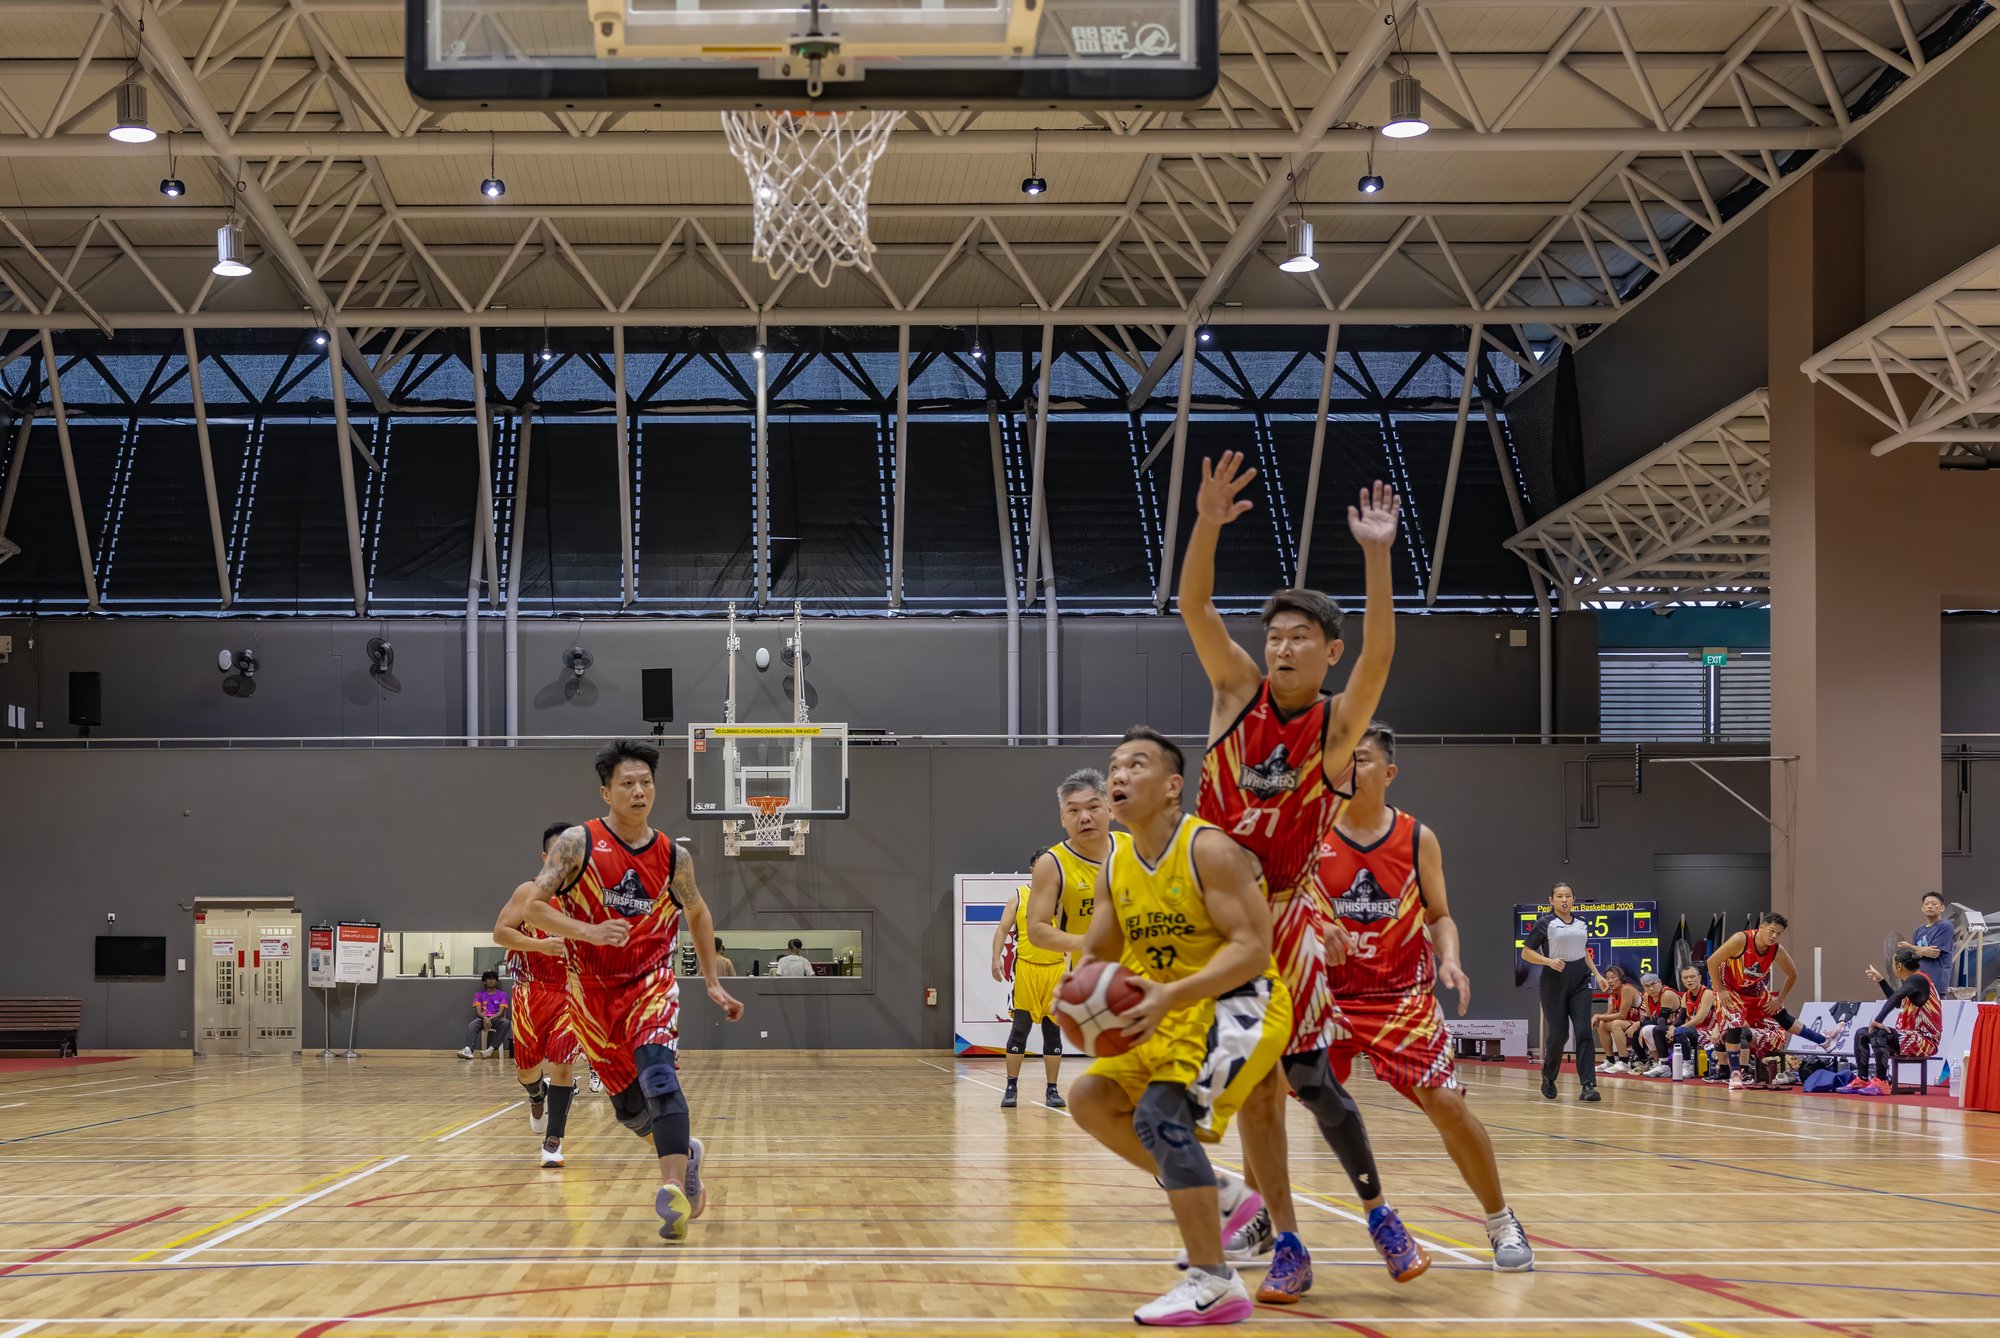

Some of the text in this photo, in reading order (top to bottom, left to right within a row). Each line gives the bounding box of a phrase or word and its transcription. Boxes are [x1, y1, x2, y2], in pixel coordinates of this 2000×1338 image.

[1707, 656, 1722, 664] EXIT
[1232, 807, 1281, 838] 87
[604, 891, 653, 913] WHISPERERS
[1334, 900, 1397, 916] WHISPERERS
[1639, 920, 1645, 929] 0
[1146, 945, 1178, 970] 37
[1640, 958, 1652, 974] 5
